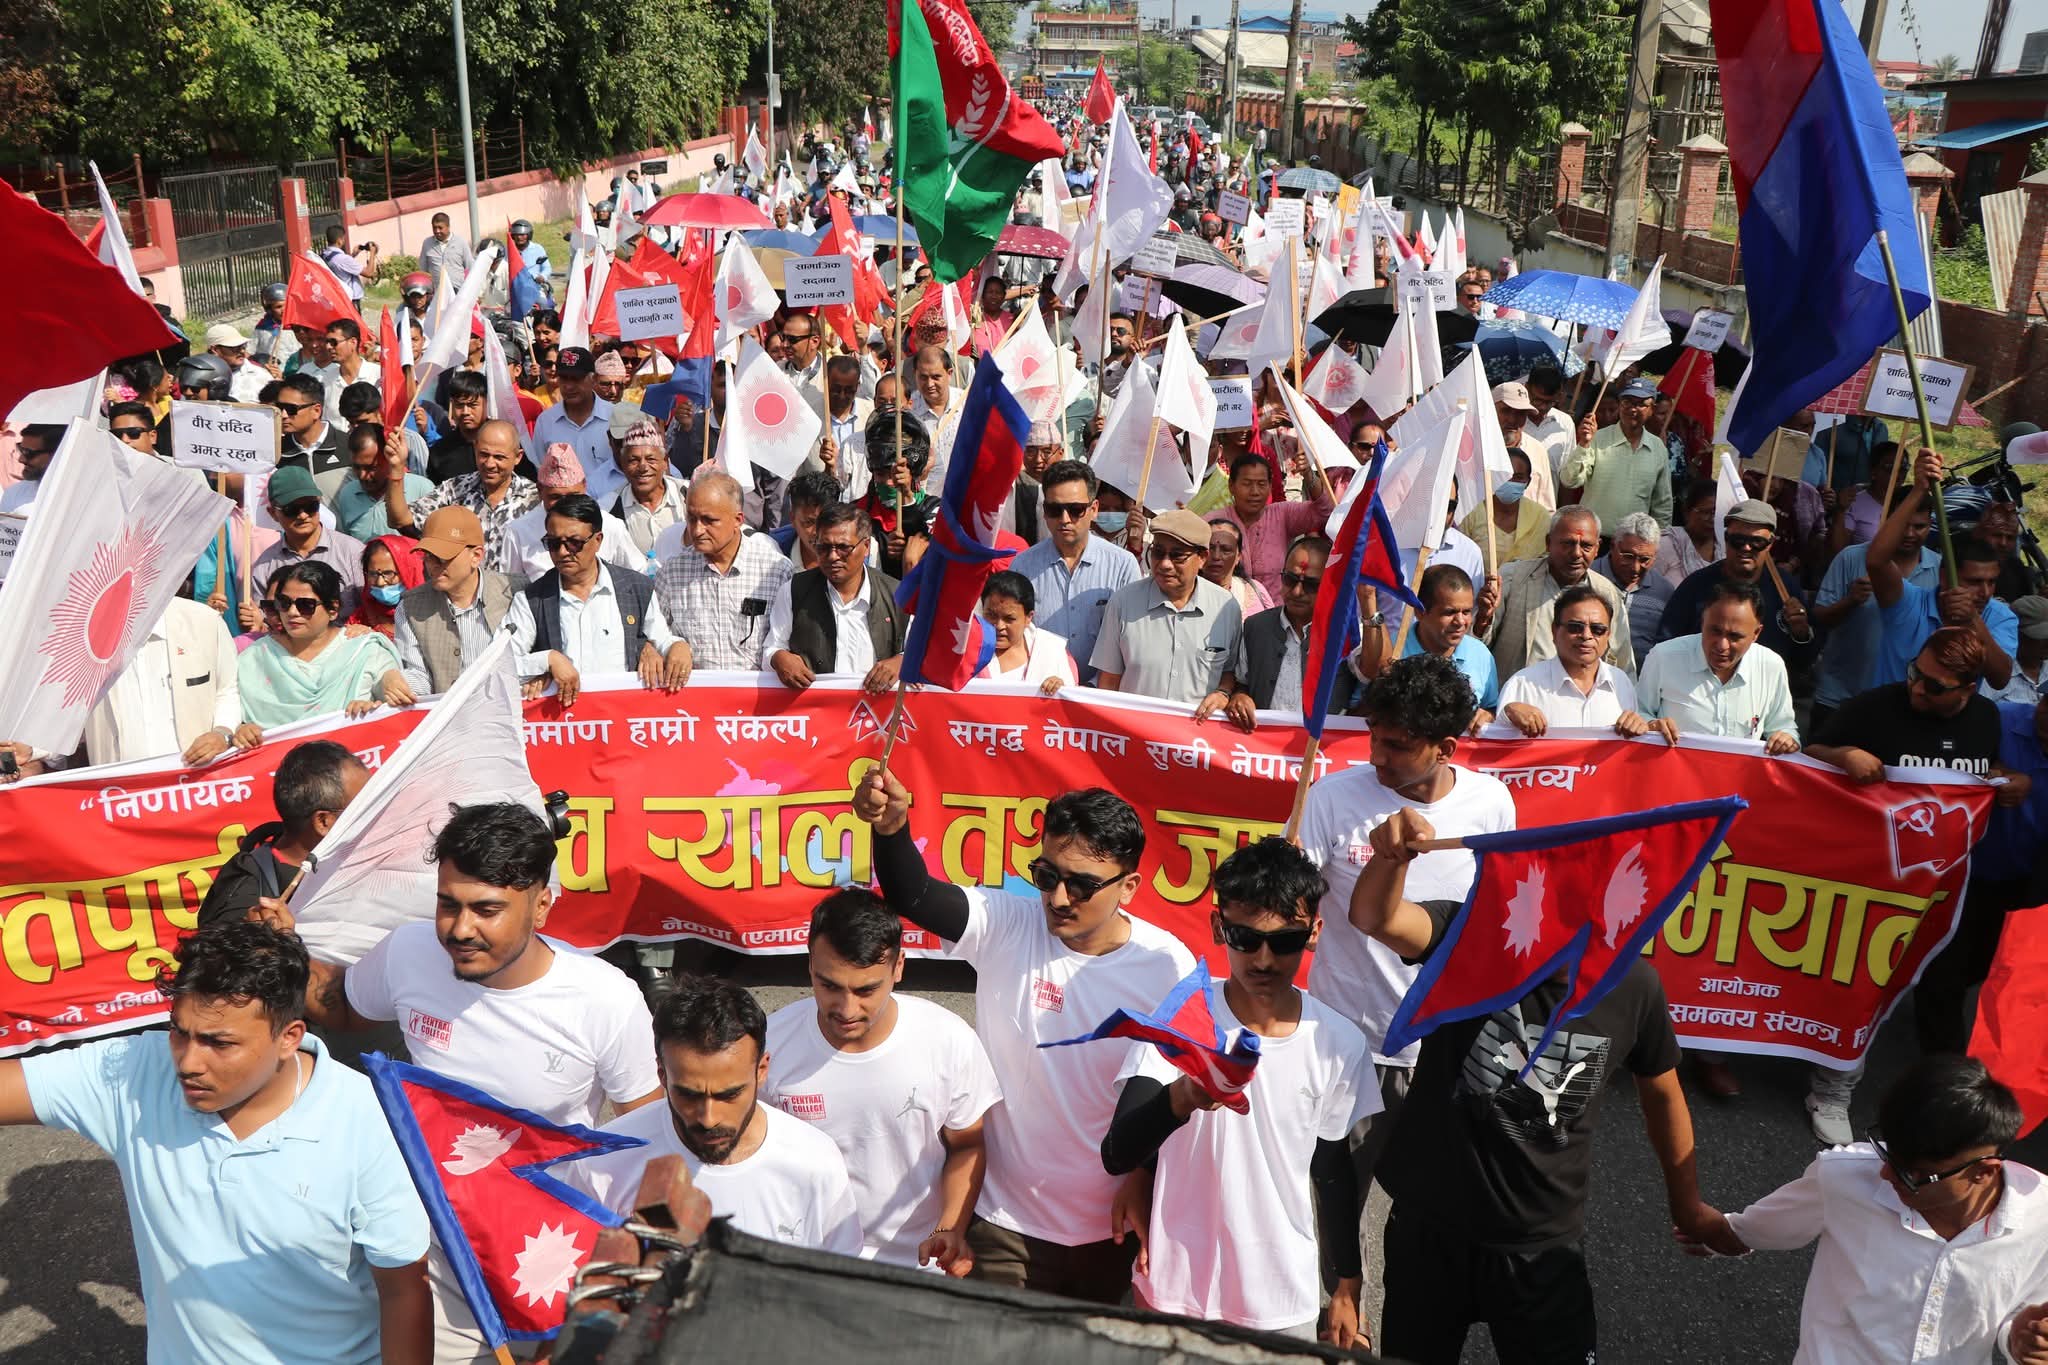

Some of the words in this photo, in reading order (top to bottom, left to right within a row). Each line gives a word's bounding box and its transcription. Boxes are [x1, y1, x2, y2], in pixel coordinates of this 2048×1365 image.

[795, 262, 841, 271] सामाजिक
[622, 298, 644, 309] शान्ति
[793, 292, 824, 300] कायम
[1919, 373, 1952, 388] रक्षाको
[191, 415, 213, 431] वीर
[216, 418, 254, 434] सहिद
[190, 443, 223, 458] अमर
[626, 709, 700, 748] हाम्रो
[714, 709, 819, 748] संकल्प,
[947, 719, 1028, 757] समृद्ध
[1043, 718, 1131, 757] नेपाल
[1144, 737, 1216, 771] सुखी
[660, 916, 735, 942] नेकपा
[1699, 976, 1782, 998] आयोजक
[95, 989, 169, 1016] शनिबा
[421, 1016, 451, 1032] CENTRAL
[1668, 1003, 1759, 1029] समन्वय
[420, 1025, 450, 1042] COLLEGE
[791, 1095, 823, 1105] CENTRAL
[792, 1104, 825, 1113] COLLEGE
